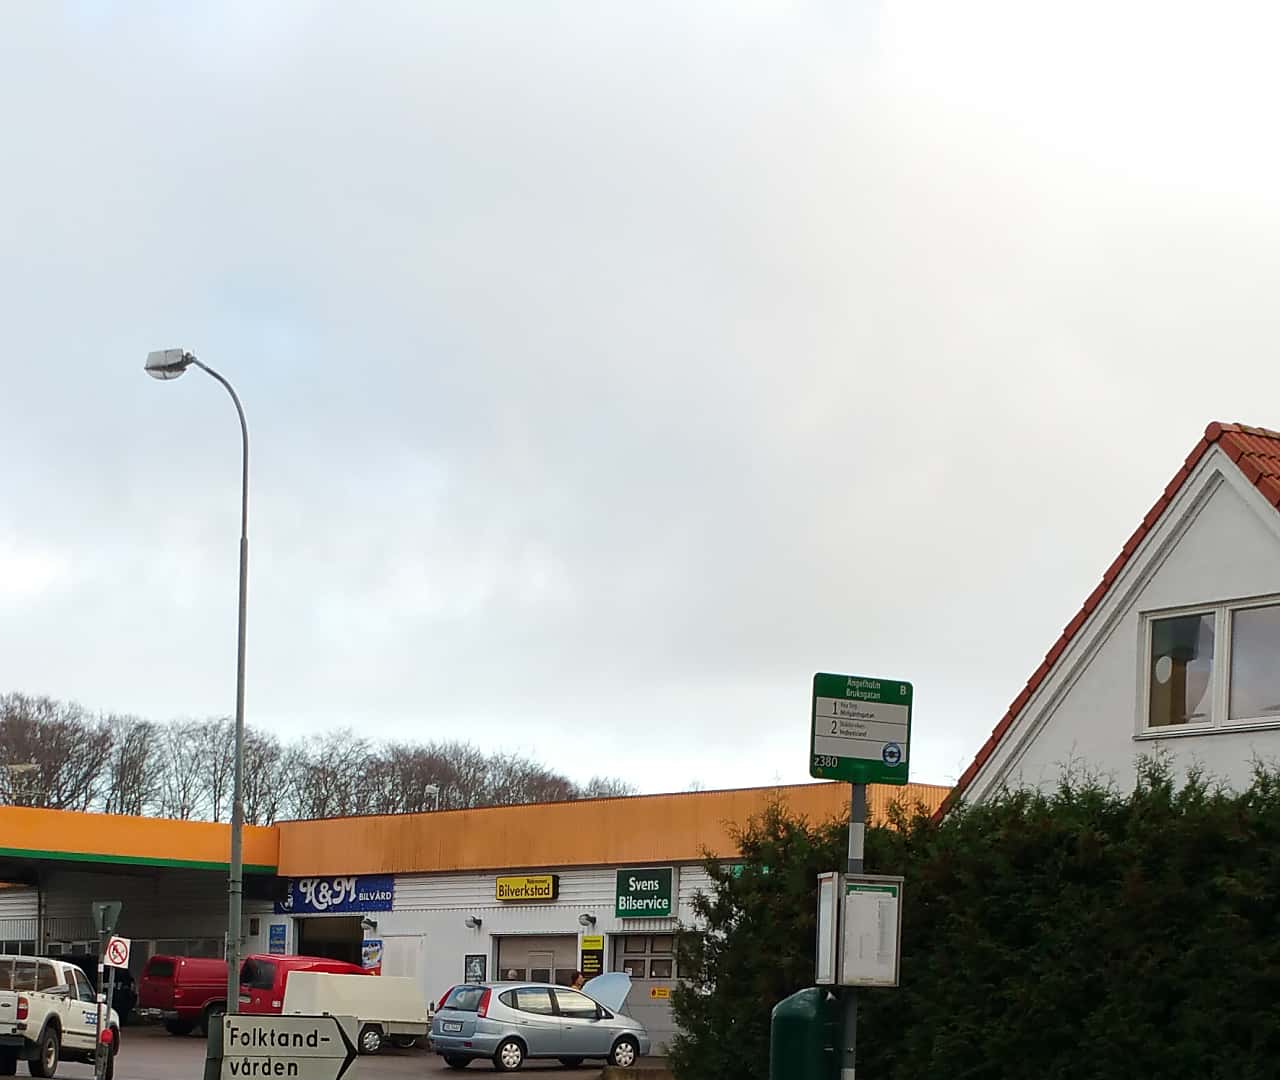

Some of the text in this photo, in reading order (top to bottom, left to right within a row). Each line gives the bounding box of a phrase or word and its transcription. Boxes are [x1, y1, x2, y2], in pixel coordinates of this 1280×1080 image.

[900, 685, 907, 696] B
[833, 701, 838, 715] 1
[831, 720, 838, 735] 2
[815, 756, 838, 768] z380
[498, 883, 550, 897] Bilverkstad
[628, 877, 660, 892] Svens
[299, 878, 392, 911] K&M BILVÅRD
[618, 895, 669, 911] Bilservice
[230, 1027, 331, 1048] Folktand-
[230, 1057, 298, 1076] vården
